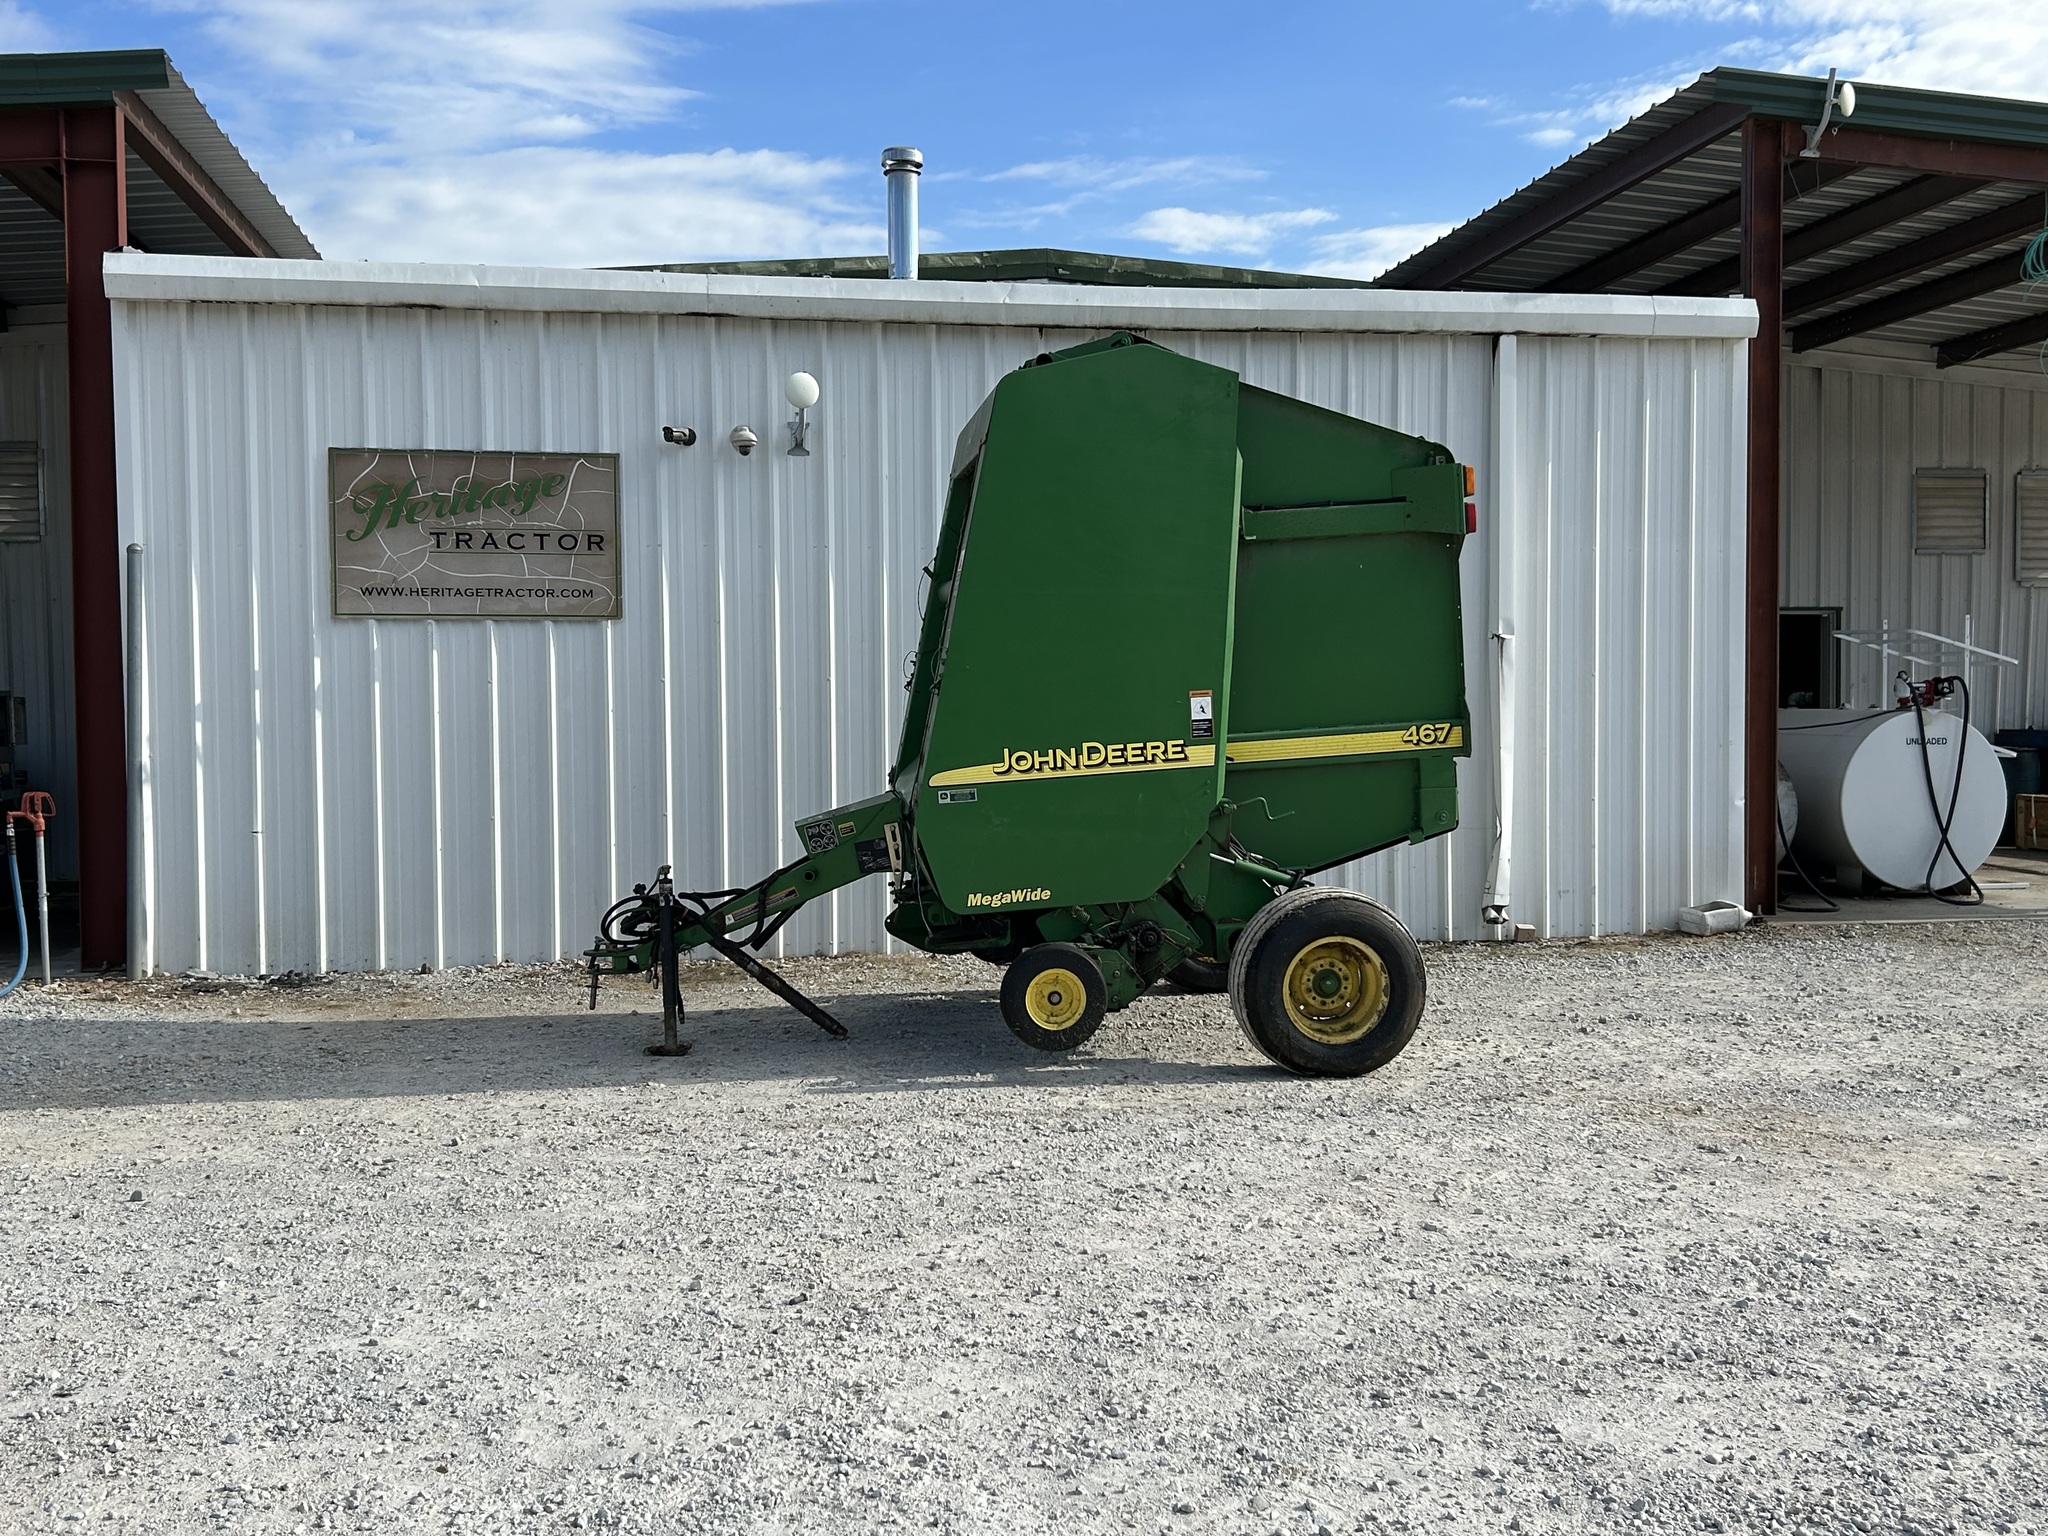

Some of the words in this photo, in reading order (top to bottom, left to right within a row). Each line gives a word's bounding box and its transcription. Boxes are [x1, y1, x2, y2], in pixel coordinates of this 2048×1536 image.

[345, 474, 566, 542] Heritage
[429, 531, 606, 551] TRACTOR
[359, 586, 594, 599] WWW.HERITAGETRACTOR.COM
[1402, 722, 1452, 745] 467
[1905, 737, 1948, 746] UNLADED
[993, 747, 1080, 775] JOHN
[1081, 739, 1188, 767] DEERE
[966, 887, 1052, 908] MegaWide
